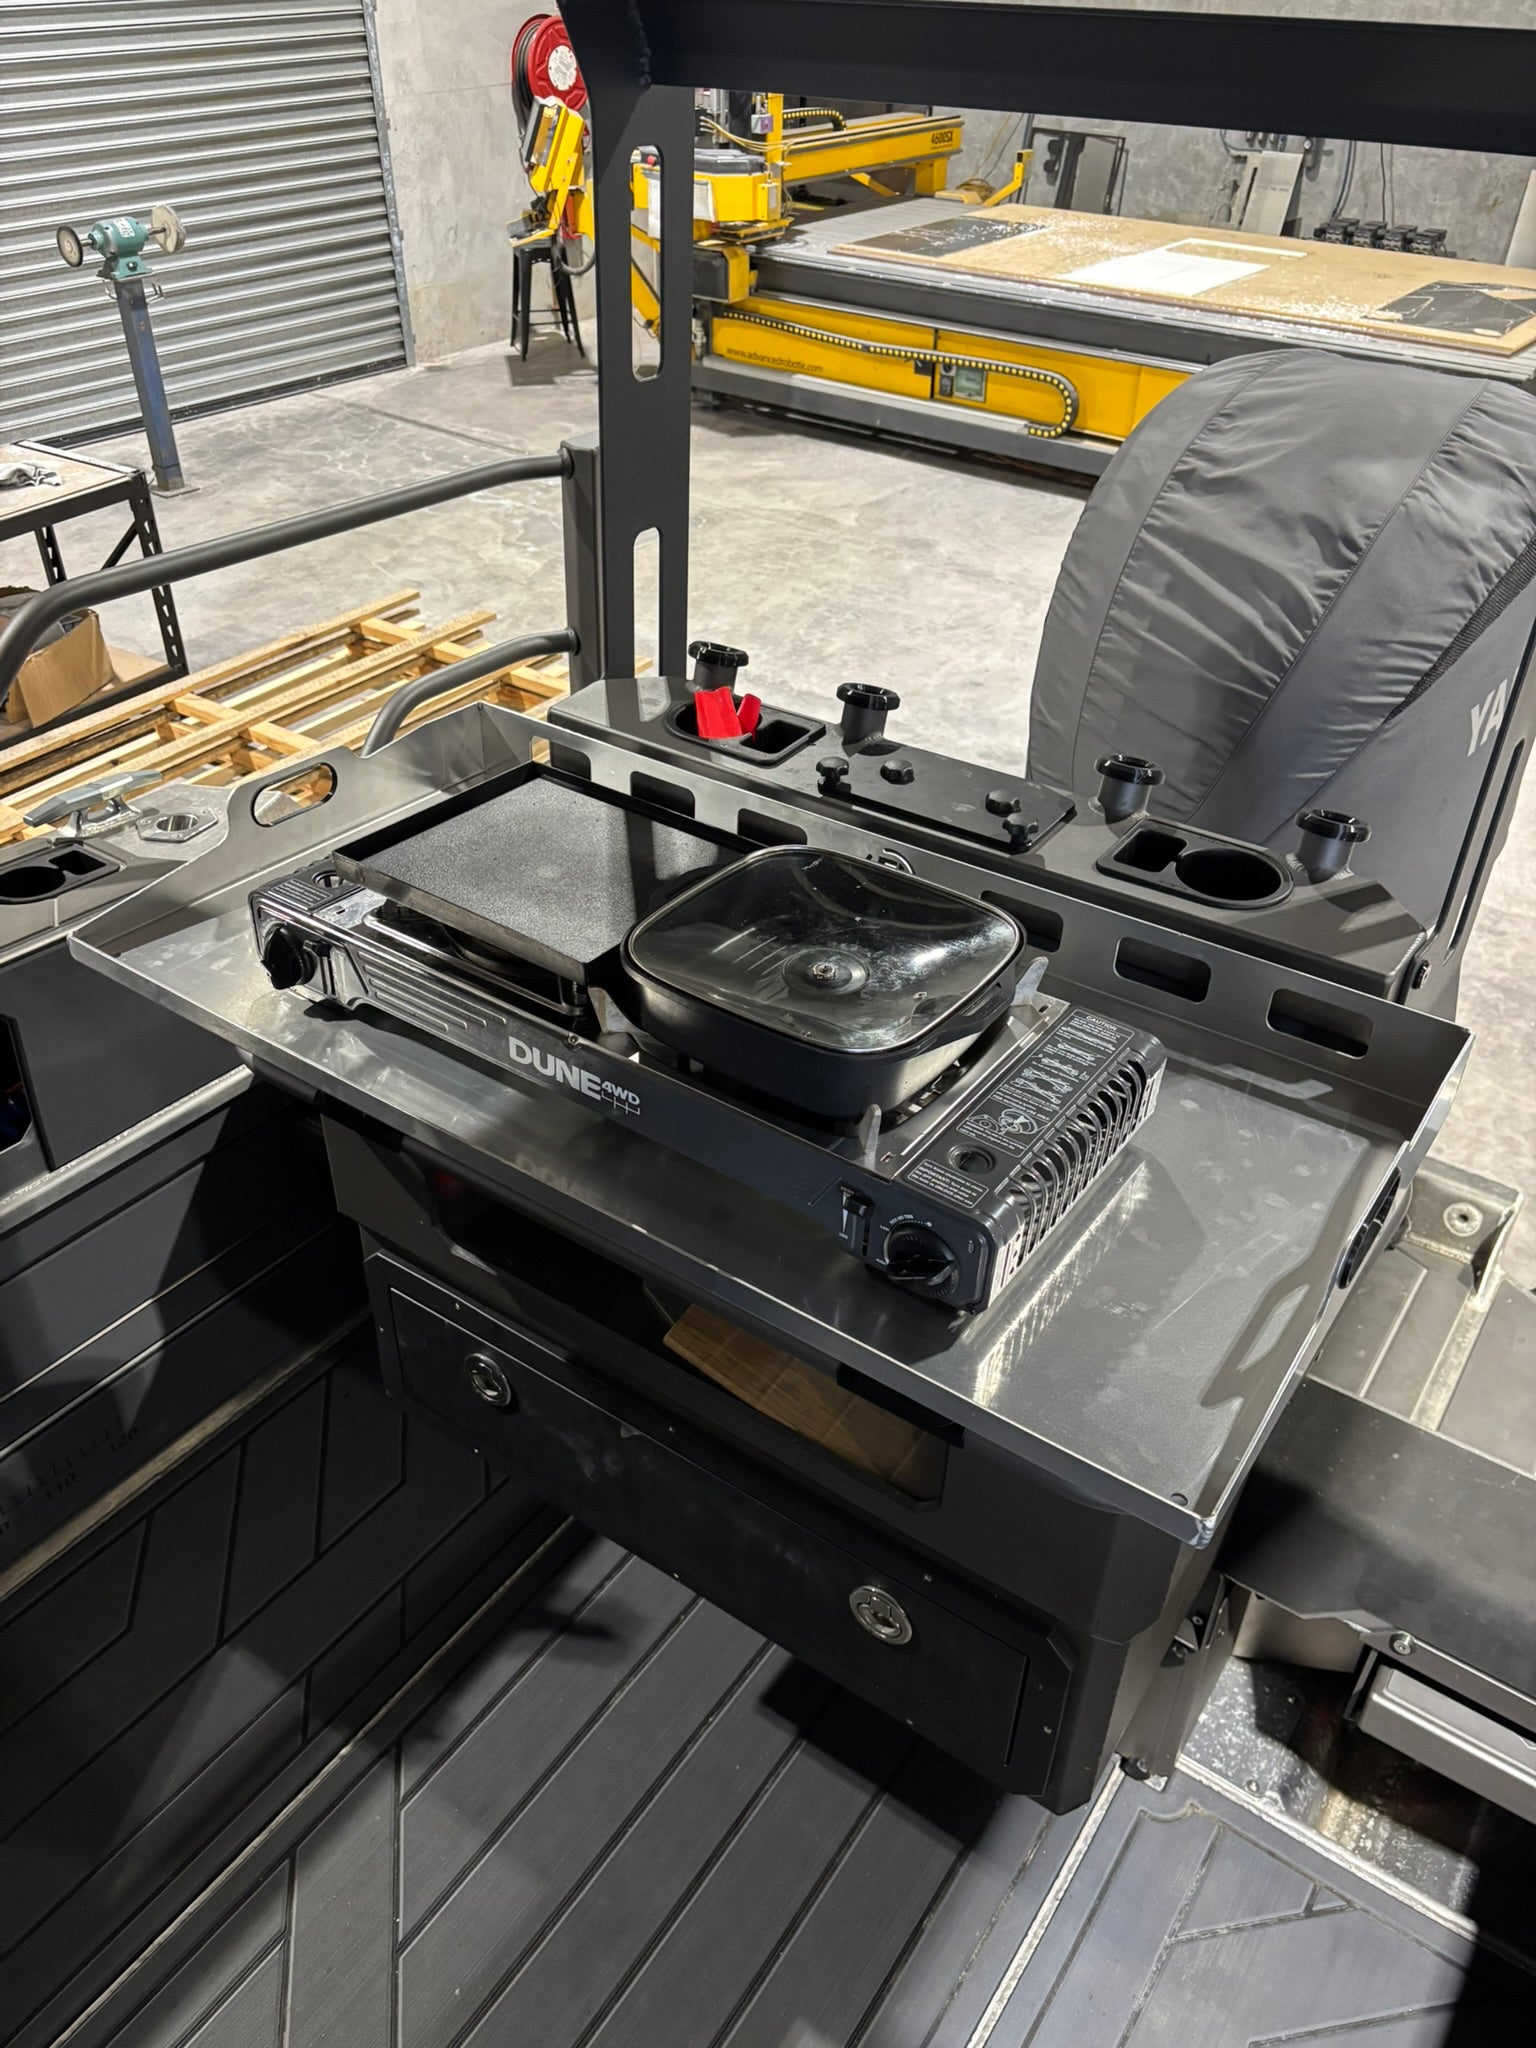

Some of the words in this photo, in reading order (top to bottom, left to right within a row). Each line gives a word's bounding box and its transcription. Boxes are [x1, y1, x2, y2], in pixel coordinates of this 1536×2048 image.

[1086, 1015, 1118, 1031] CAUTION
[508, 1036, 602, 1101] DUNE
[601, 1080, 641, 1106] 4WD
